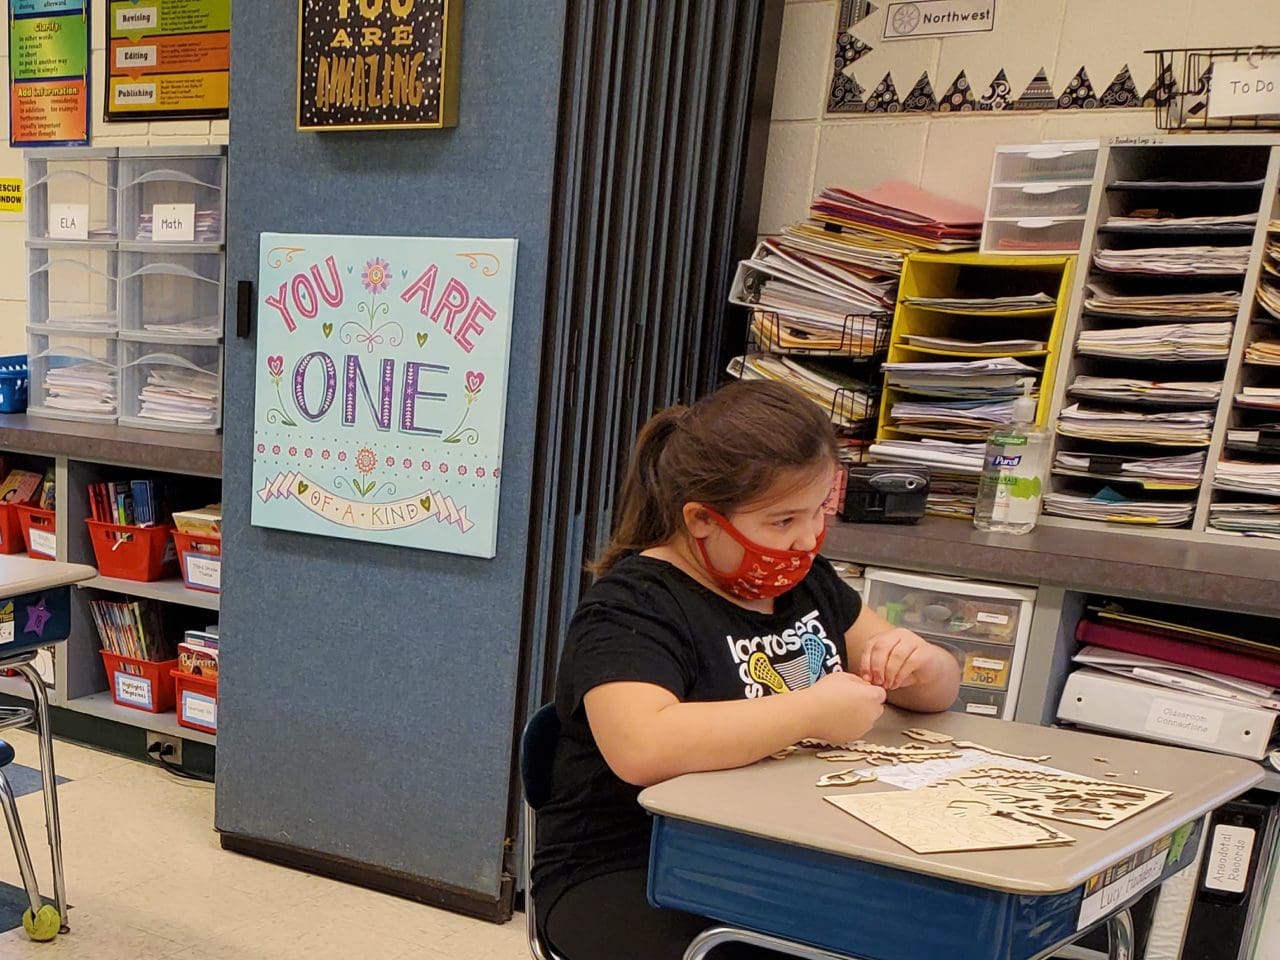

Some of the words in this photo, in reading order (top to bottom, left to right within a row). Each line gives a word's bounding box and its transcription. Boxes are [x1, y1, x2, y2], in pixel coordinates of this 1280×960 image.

[122, 13, 151, 23] Revising
[923, 8, 991, 25] Northwest
[330, 25, 414, 47] ARE
[124, 51, 148, 61] Editing
[316, 52, 425, 112] AMAZING
[118, 89, 154, 98] Publishing
[59, 217, 77, 231] ELA
[160, 217, 183, 231] Math
[265, 255, 344, 333] YOU
[400, 264, 497, 353] ARE
[291, 350, 450, 438] ONE
[310, 490, 332, 512] OF
[342, 507, 356, 525] A
[371, 504, 418, 527] KIND
[1163, 708, 1207, 721] Classroom
